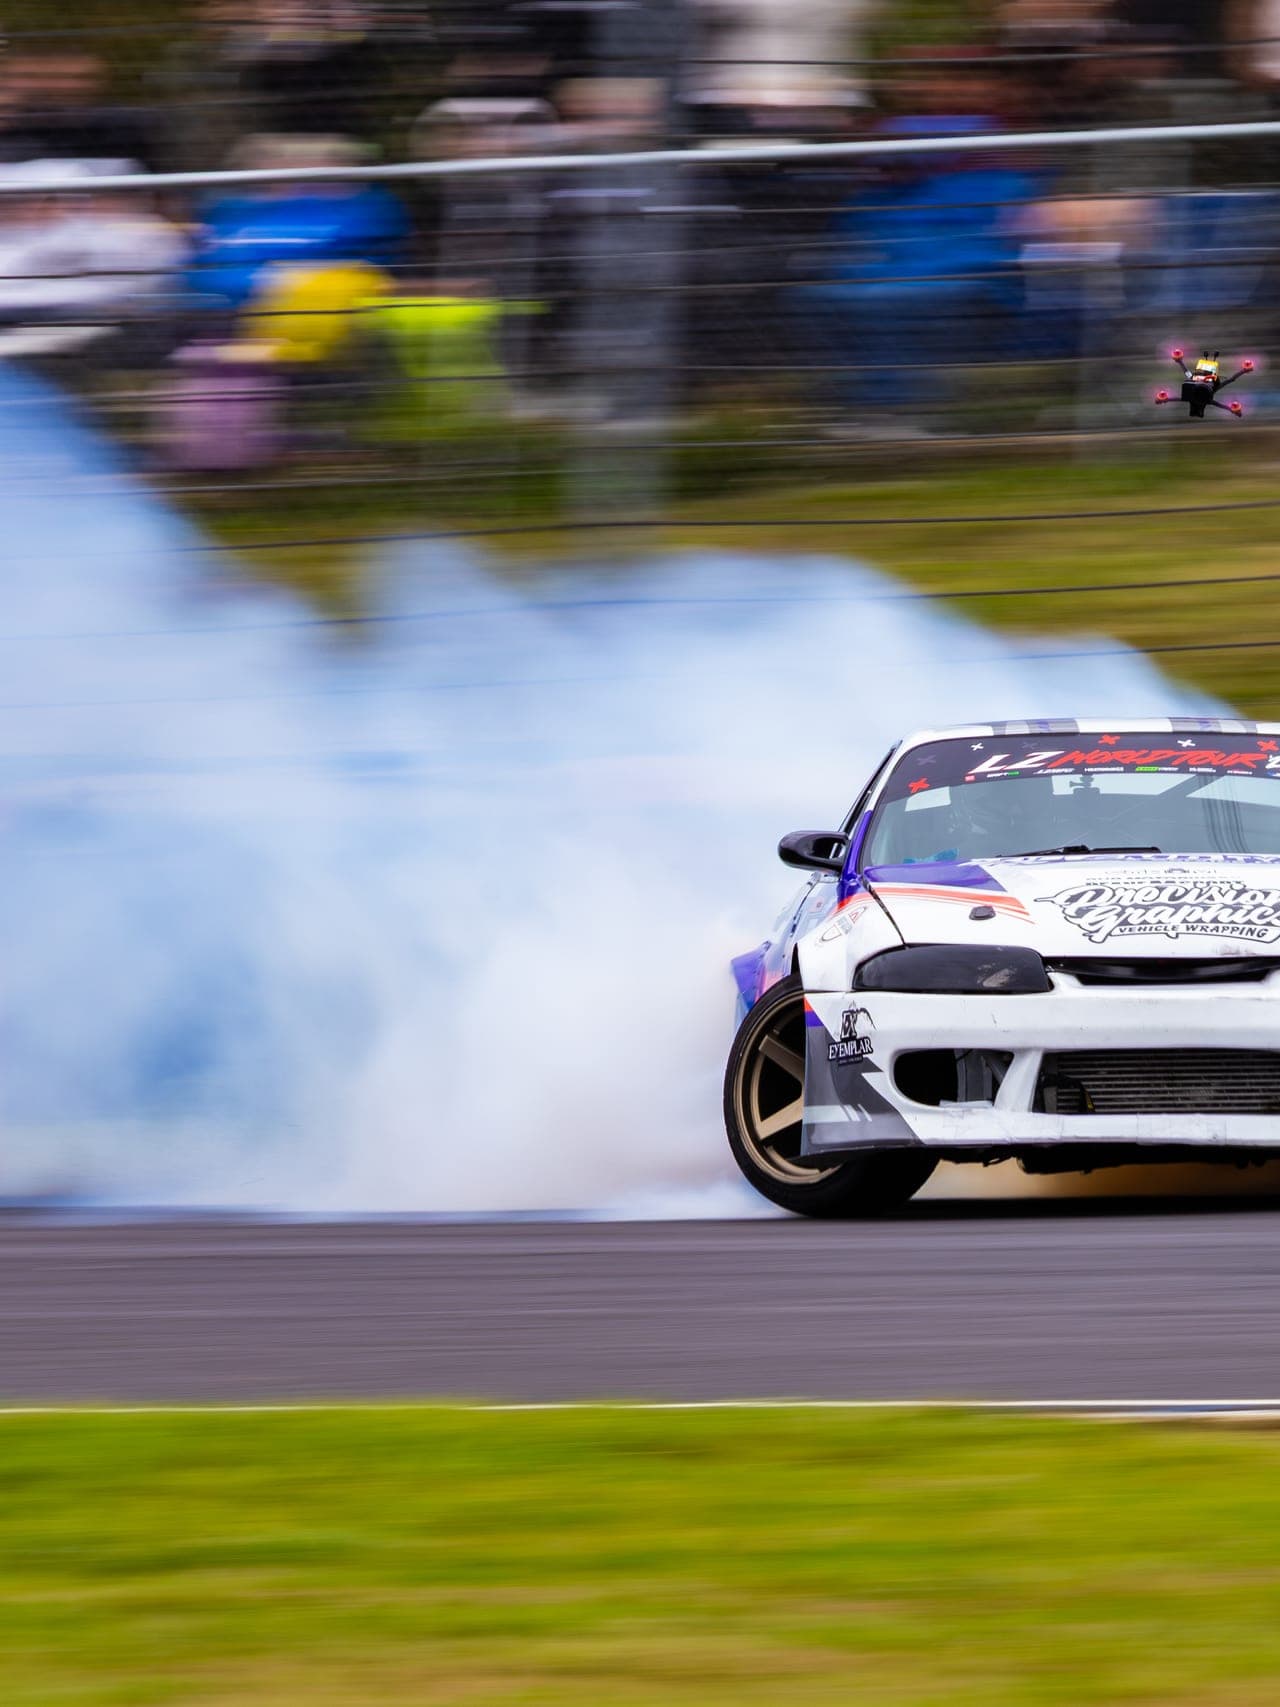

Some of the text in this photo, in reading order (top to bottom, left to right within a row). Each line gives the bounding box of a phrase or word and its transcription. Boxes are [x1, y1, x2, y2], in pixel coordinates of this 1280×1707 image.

[967, 751, 1065, 774] LZ
[1118, 924, 1269, 939] VEHICLE WRAPPING
